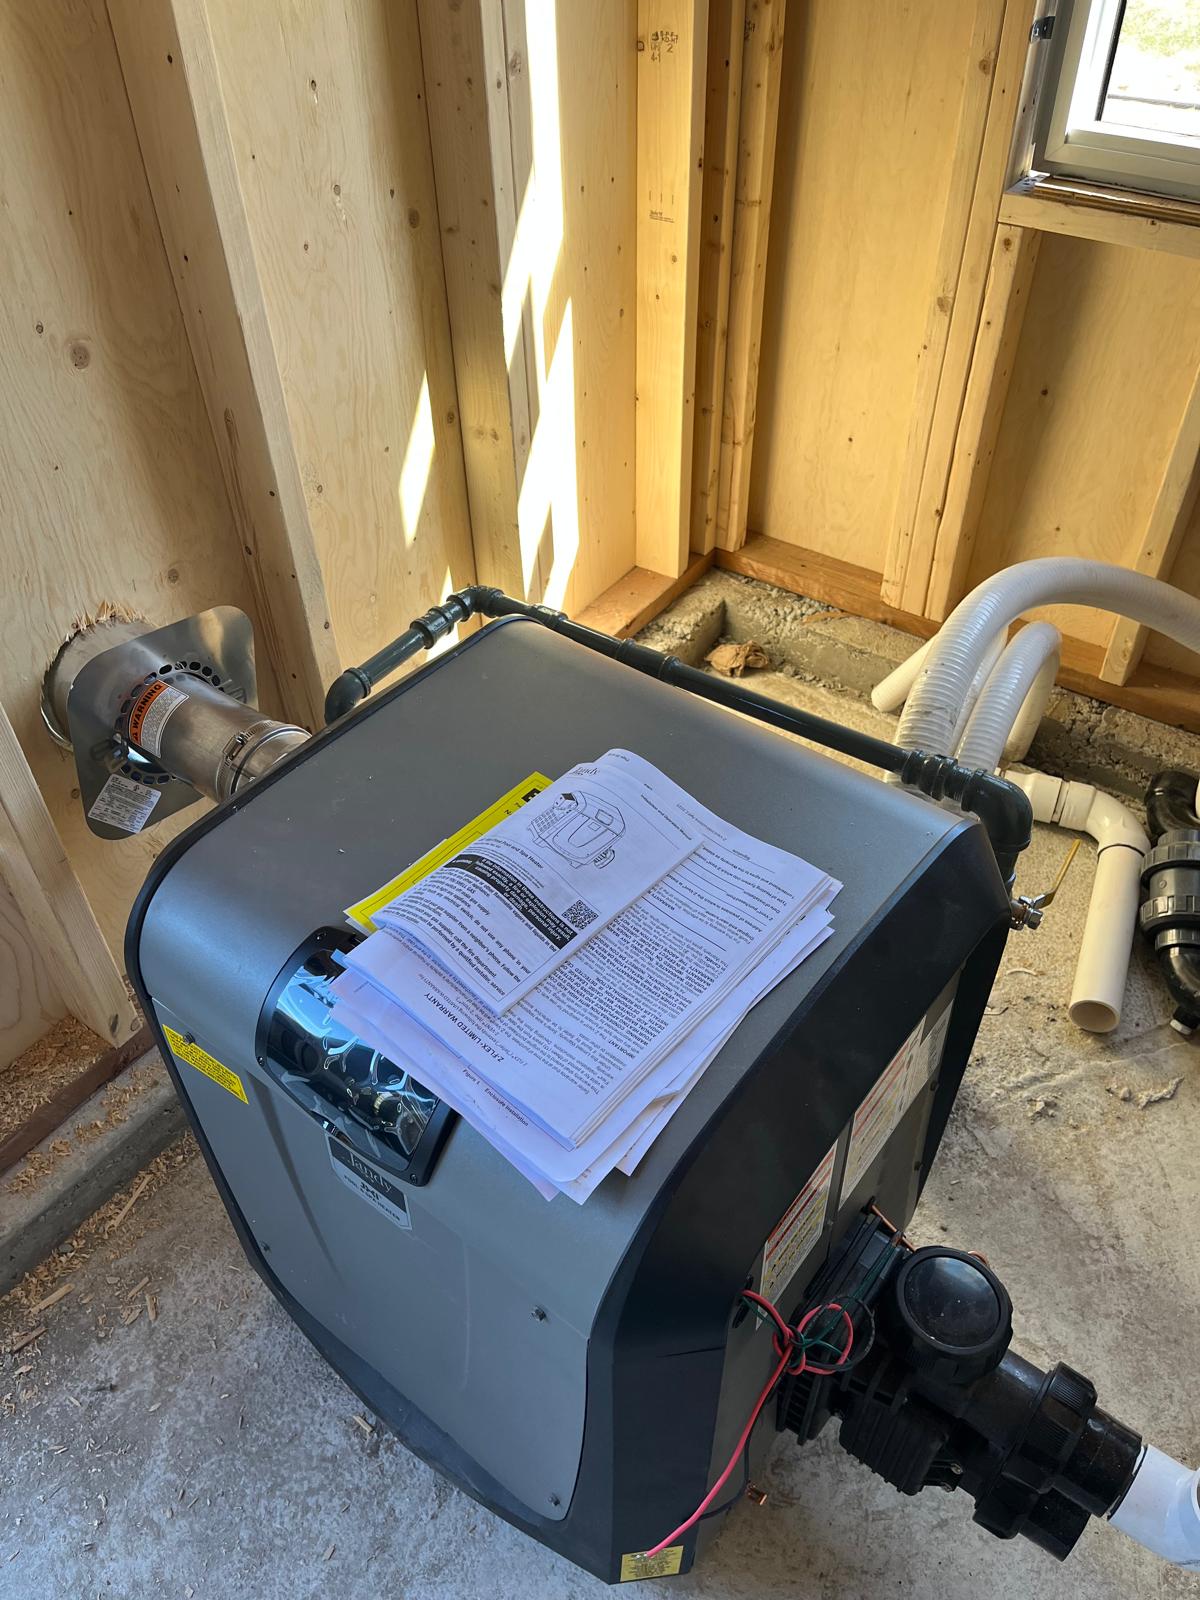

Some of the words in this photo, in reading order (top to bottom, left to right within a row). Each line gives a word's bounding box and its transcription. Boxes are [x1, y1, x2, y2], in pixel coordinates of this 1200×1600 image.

[131, 683, 163, 731] WARNING
[639, 793, 658, 810] Installation
[678, 828, 692, 841] Manual
[501, 839, 512, 847] Pool
[509, 844, 520, 852] and
[518, 849, 529, 858] Spa
[526, 855, 544, 870] Heater
[466, 886, 475, 894] GAS
[474, 864, 491, 878] causing
[489, 875, 511, 892] property
[508, 889, 529, 909] damage,
[527, 907, 549, 928] personal
[546, 925, 562, 941] injury,
[490, 870, 509, 884] exactly,
[511, 884, 521, 894] fire
[524, 896, 547, 919] explosion
[545, 916, 557, 928] may
[555, 925, 571, 941] result,
[491, 863, 518, 883] information
[521, 885, 535, 899] these
[533, 897, 560, 924] instructions
[563, 925, 573, 935] not
[502, 891, 510, 899] or
[508, 896, 523, 911] death.
[650, 892, 675, 911] WARRANTY
[703, 896, 716, 906] which
[734, 896, 758, 911] purchased
[775, 896, 787, 906] Type
[720, 906, 740, 919] premises
[767, 904, 780, 914] Date
[482, 884, 494, 893] other
[492, 891, 513, 911] flammable
[512, 909, 526, 923] vapors
[524, 921, 533, 930] and
[531, 928, 546, 942] liquids
[548, 944, 557, 953] the
[727, 922, 737, 930] end
[743, 919, 762, 933] Address
[430, 915, 439, 923] gas
[453, 934, 462, 943] call
[460, 941, 468, 949] the
[467, 947, 475, 956] fire
[615, 926, 632, 939] UNDER
[629, 923, 640, 933] MAY
[735, 927, 754, 941] Original
[442, 909, 459, 923] supplier
[457, 921, 468, 931] from
[469, 932, 490, 952] neighbor's
[488, 950, 502, 965] phone.
[500, 963, 514, 977] Follow
[513, 975, 521, 983] the
[619, 935, 630, 945] ANY
[631, 937, 644, 948] SALE
[638, 930, 663, 950] LIMITATION
[638, 936, 652, 948] SOME
[479, 924, 488, 933] not
[487, 931, 496, 940] use
[495, 939, 503, 948] any
[502, 947, 516, 960] phone
[520, 964, 531, 975] your
[593, 948, 607, 960] BEEN
[629, 942, 654, 961] INCLUDING
[643, 946, 655, 956] THIS
[662, 947, 679, 960] ABOVE
[431, 925, 452, 944] performed
[458, 949, 476, 968] qualified
[474, 965, 491, 983] installer,
[489, 981, 505, 996] service
[605, 957, 616, 967] HAS
[625, 957, 646, 974] INDIRECT
[662, 959, 683, 976] IMPOSED
[573, 966, 598, 986] DETECTED
[613, 957, 645, 980] INSTALLATION
[615, 964, 640, 984] WARRANTY
[567, 968, 588, 986] LEAKAGE
[644, 978, 653, 986] THE
[684, 968, 710, 987] WARRANTY
[556, 980, 568, 991] ACID
[565, 981, 585, 996] VENTING
[579, 984, 594, 997] SIGNS
[588, 984, 604, 997] CAUSE
[639, 981, 661, 997] EXPRESS
[567, 988, 580, 999] HIGH
[585, 994, 596, 1004] AND
[660, 994, 677, 1007] OTHER
[423, 991, 458, 1023] WARRANTY
[578, 997, 591, 1007] WITH
[593, 994, 615, 1011] POSSIBLE
[604, 988, 640, 1015] DETERIORATION
[589, 1005, 625, 1030] CONDENSATION
[594, 1001, 620, 1020] APPLIANCE
[614, 1002, 636, 1018] CONTENT
[614, 1008, 625, 1017] FOR
[618, 1017, 639, 1033] HEATING
[624, 1014, 638, 1026] BASIS
[635, 1016, 648, 1026] ACID
[456, 1020, 481, 1044] LIMITED
[637, 1023, 656, 1038] ANNUAL
[638, 1030, 652, 1042] YOUR
[647, 1024, 660, 1034] HIGH
[462, 1068, 477, 1082] Figure
[484, 1087, 506, 1107] Enclosure
[504, 1105, 528, 1127] Installation
[347, 1152, 393, 1192] Jandy
